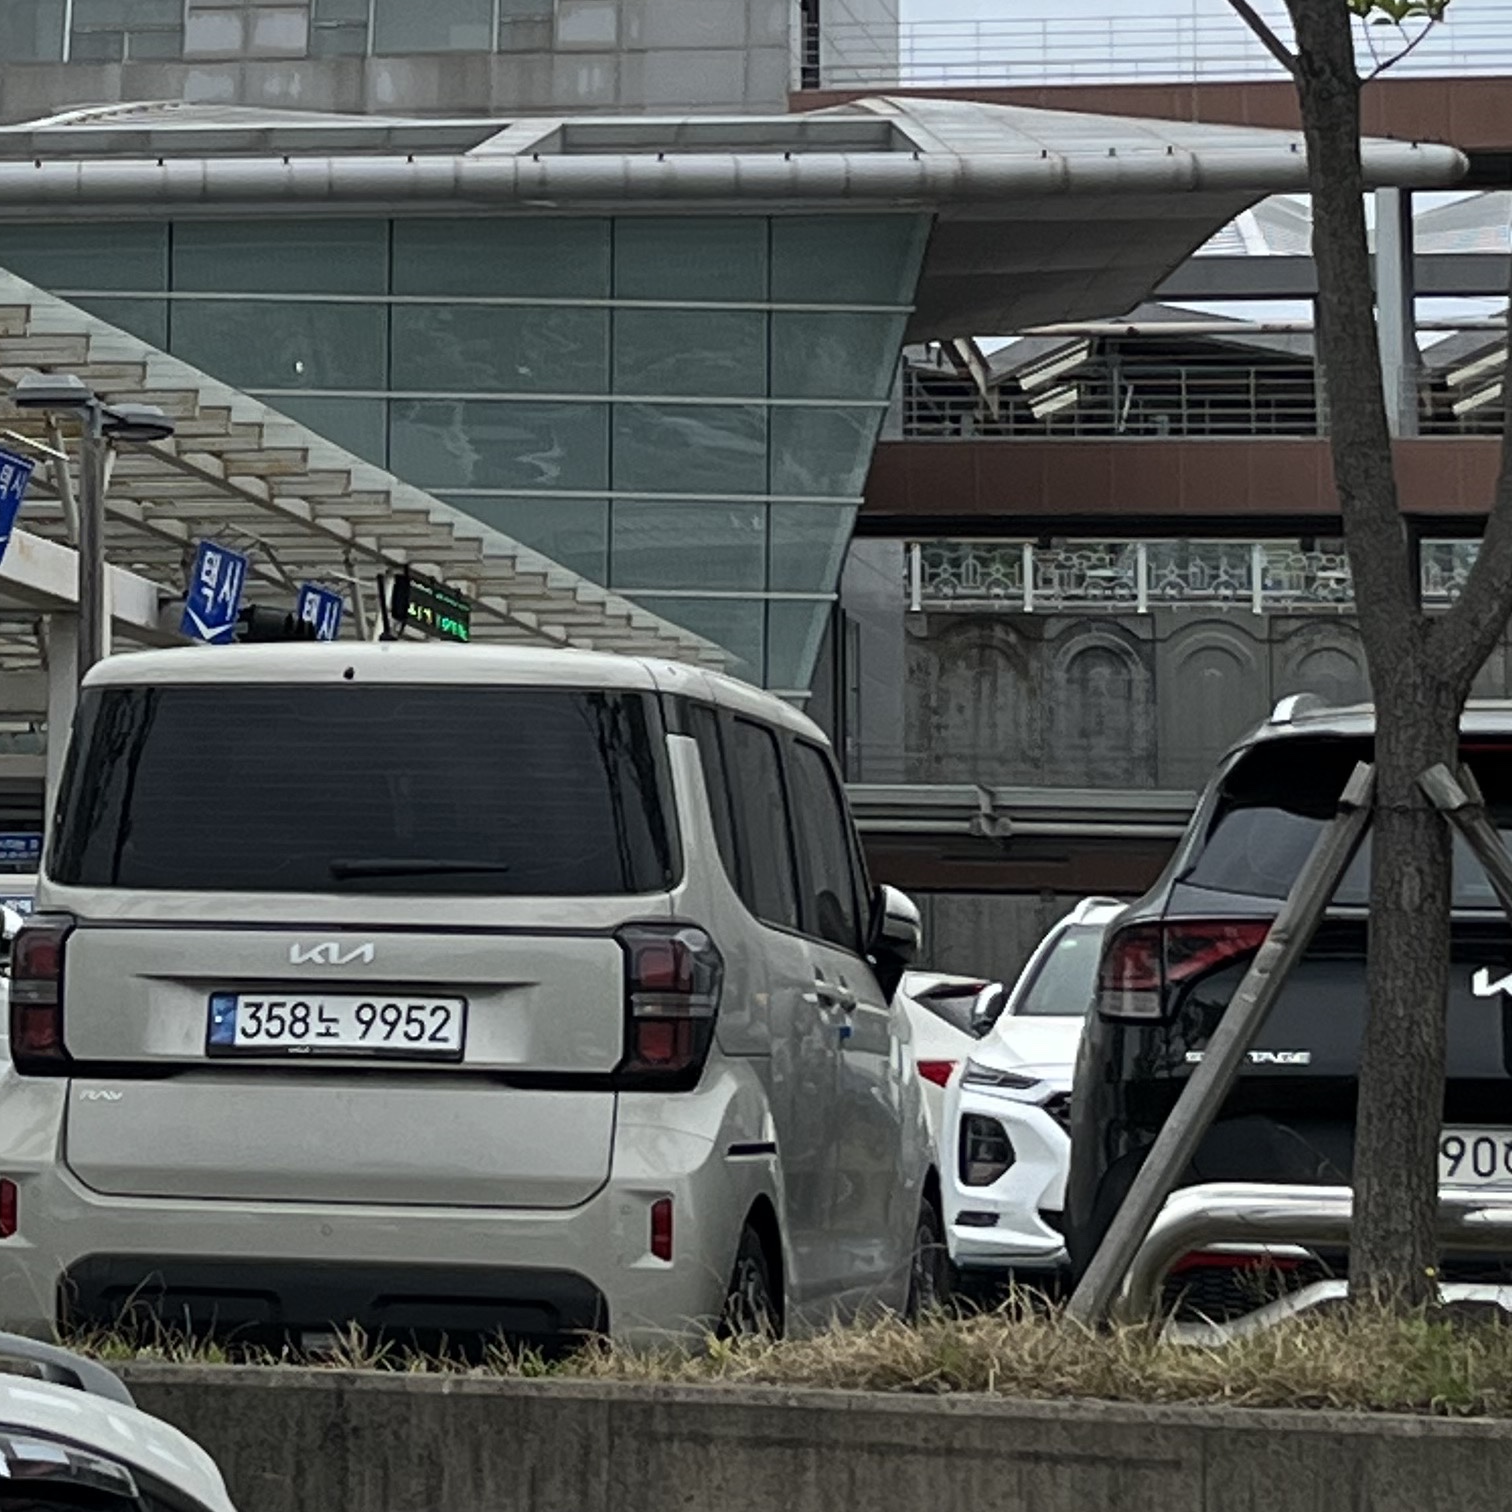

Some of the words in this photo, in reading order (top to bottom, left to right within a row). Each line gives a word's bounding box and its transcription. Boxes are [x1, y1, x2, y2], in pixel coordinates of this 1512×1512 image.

[200, 551, 243, 621] 택시
[289, 941, 375, 965] KIA
[240, 1001, 340, 1039] 358노
[354, 1003, 451, 1043] 9952
